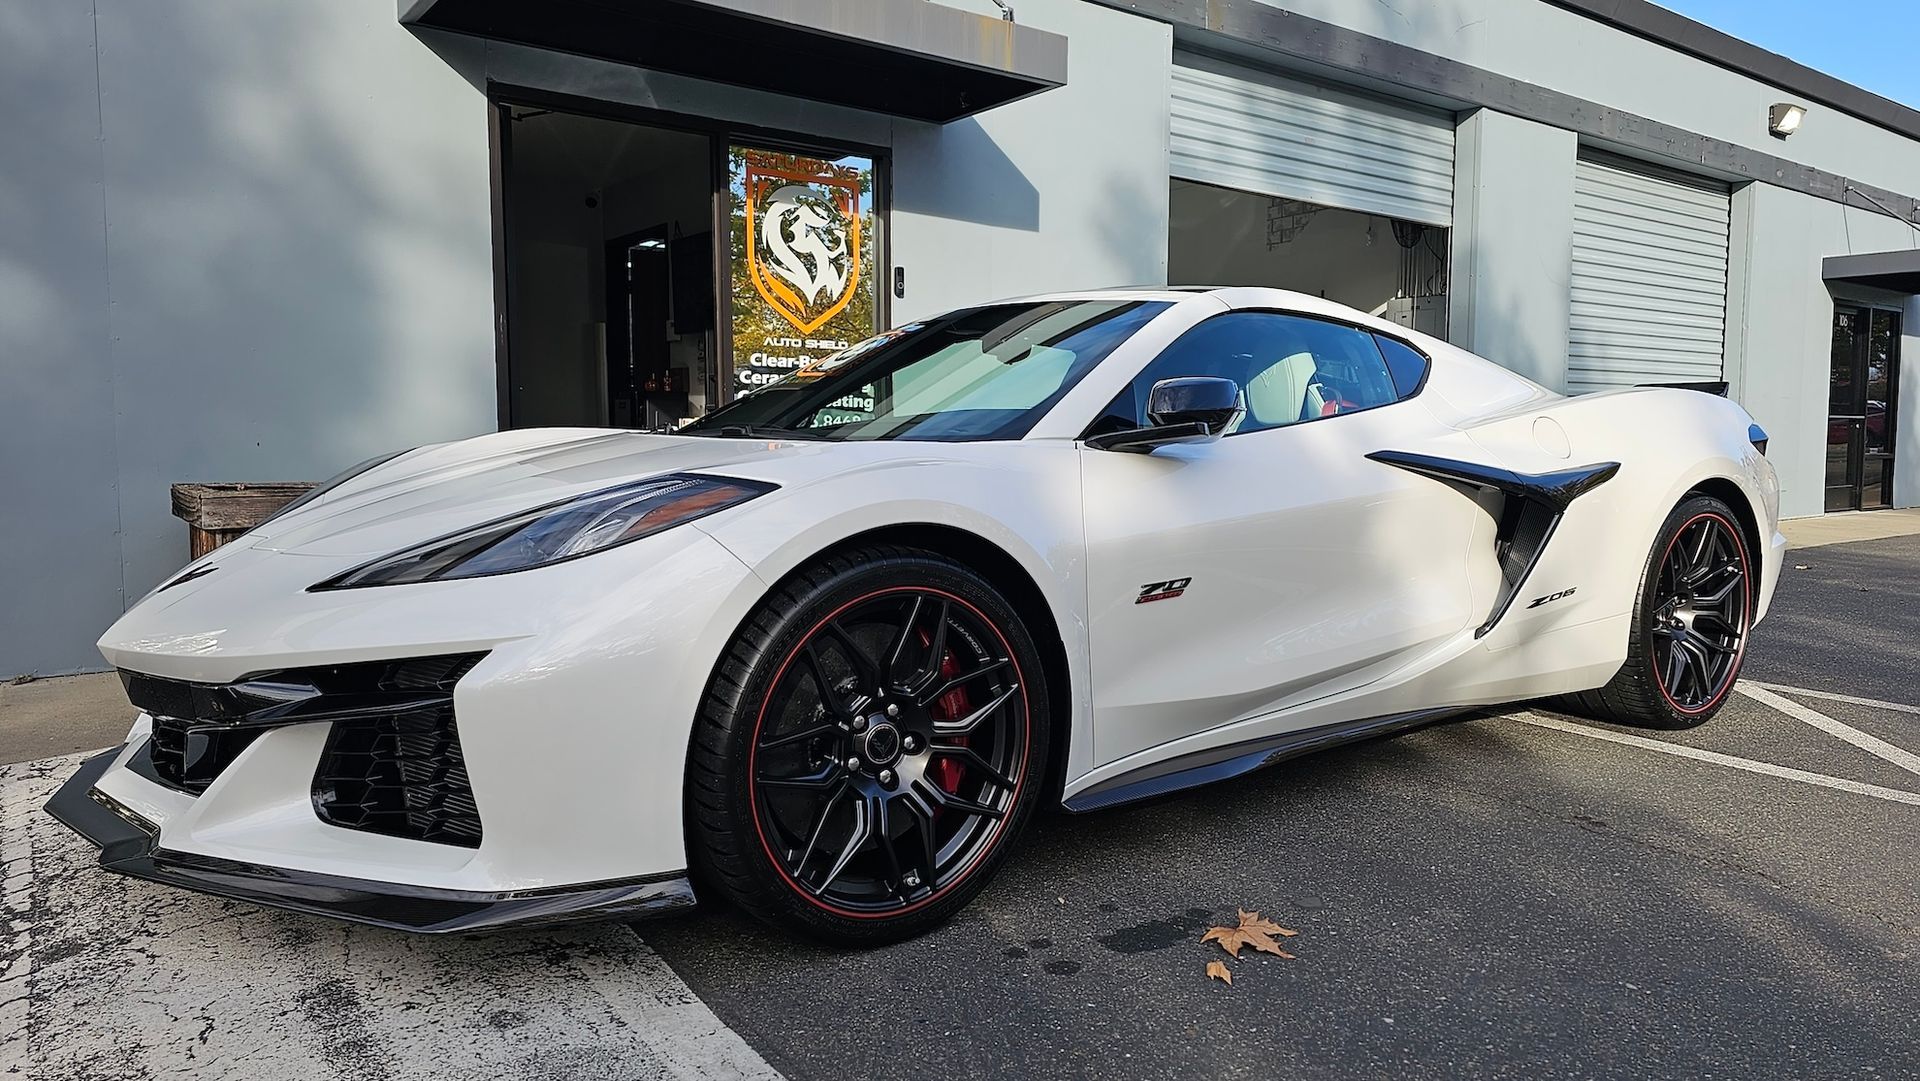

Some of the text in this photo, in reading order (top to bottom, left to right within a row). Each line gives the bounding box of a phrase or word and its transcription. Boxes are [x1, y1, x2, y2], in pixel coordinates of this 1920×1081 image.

[1839, 314, 1849, 326] 106
[763, 337, 848, 350] AUTO SHIELD
[749, 352, 819, 368] Clear-Br
[739, 370, 782, 385] Cera
[826, 395, 874, 412] ating
[1525, 587, 1577, 609] Z06
